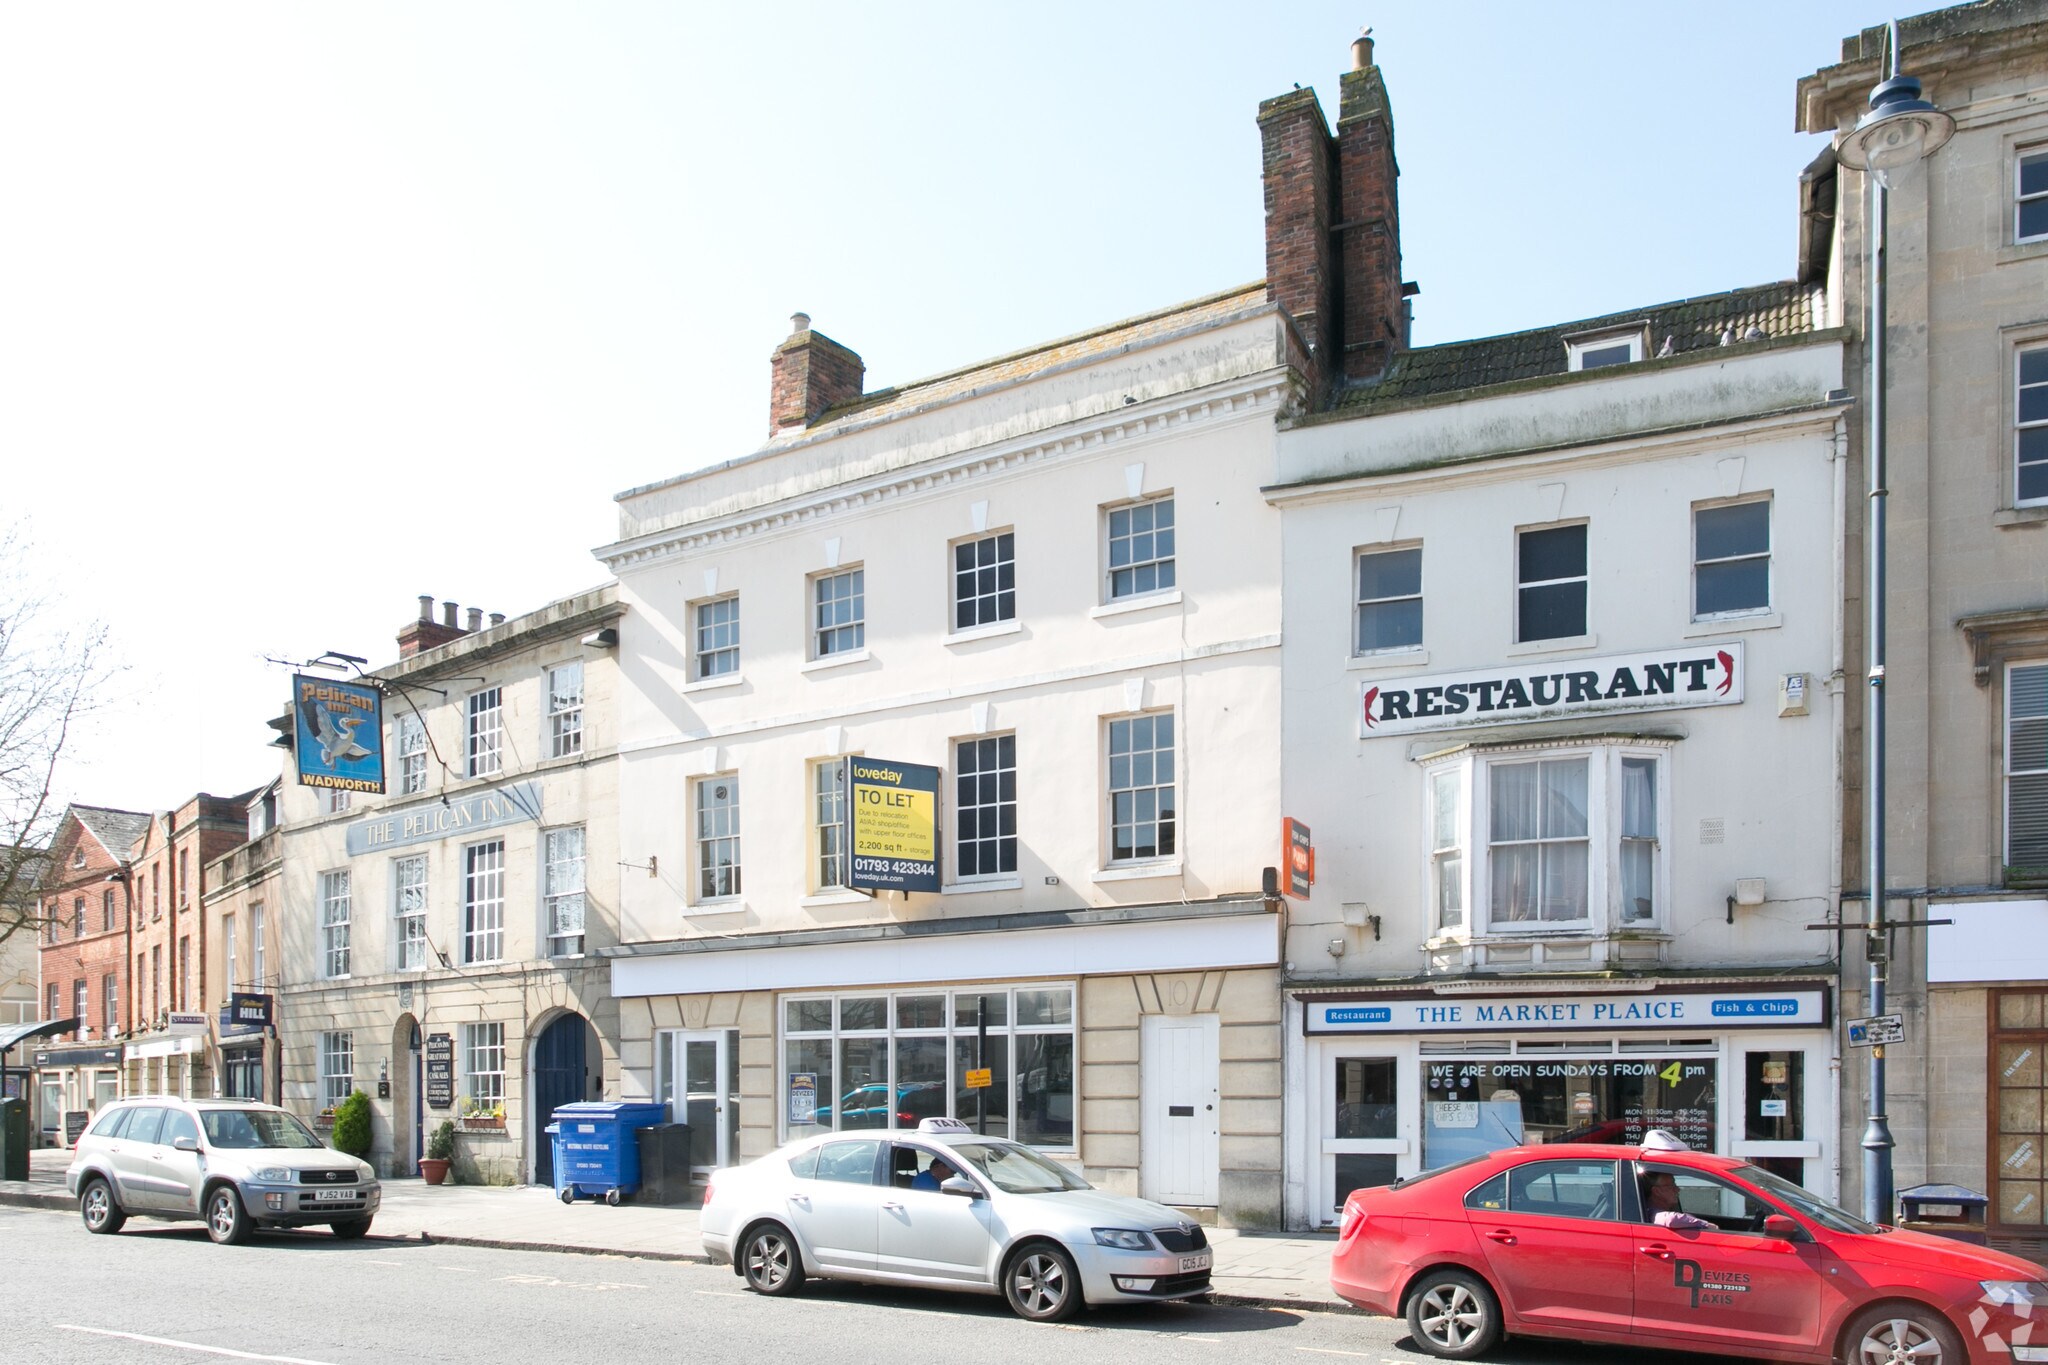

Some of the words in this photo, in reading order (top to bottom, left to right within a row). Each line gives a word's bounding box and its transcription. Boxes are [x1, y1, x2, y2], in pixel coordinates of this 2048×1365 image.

[1380, 658, 1716, 721] RESTAURANT
[301, 682, 374, 712] Pelican
[327, 701, 350, 714] Inn
[854, 764, 902, 785] loveday
[302, 774, 380, 792] WADWORTH
[859, 789, 881, 805] TO
[887, 792, 914, 808] LET
[367, 821, 394, 845] THE
[404, 803, 472, 838] PELICAN
[482, 795, 515, 821] INN
[881, 810, 908, 819] relocation
[877, 820, 910, 829] shop/office
[874, 830, 890, 839] upper
[892, 830, 905, 838] floor
[907, 832, 927, 840] offices
[859, 841, 881, 851] 2,200
[884, 844, 894, 852] sq
[896, 843, 902, 852] ft
[910, 846, 931, 855] storage
[855, 858, 889, 872] 01793
[892, 861, 935, 876] 423344
[855, 873, 904, 883] loveday.uk.com
[1168, 980, 1188, 1006] 10
[240, 1007, 265, 1020] HILL
[687, 1000, 701, 1021] 10
[1330, 1010, 1385, 1020] Restaurant
[1416, 1006, 1462, 1022] THE
[1476, 1004, 1580, 1022] MARKET
[1593, 1002, 1684, 1020] PLAICE
[1715, 1003, 1739, 1012] Fish
[1745, 1003, 1754, 1012] &
[1762, 1003, 1795, 1014] Chips
[1431, 1065, 1454, 1077] WE
[1460, 1065, 1487, 1077] ARE
[1492, 1065, 1531, 1077] OPEN
[1536, 1064, 1608, 1077] SUNDAYS
[1613, 1064, 1657, 1076] FROM
[1660, 1061, 1682, 1088] 4
[1685, 1065, 1705, 1078] pm
[1435, 1103, 1460, 1112] CHEESE
[1436, 1112, 1454, 1121] CHIPS
[929, 1120, 967, 1128] TAXI
[1680, 1125, 1707, 1133] 10:45pm
[319, 1190, 338, 1199] YJ52
[340, 1190, 354, 1199] VAB
